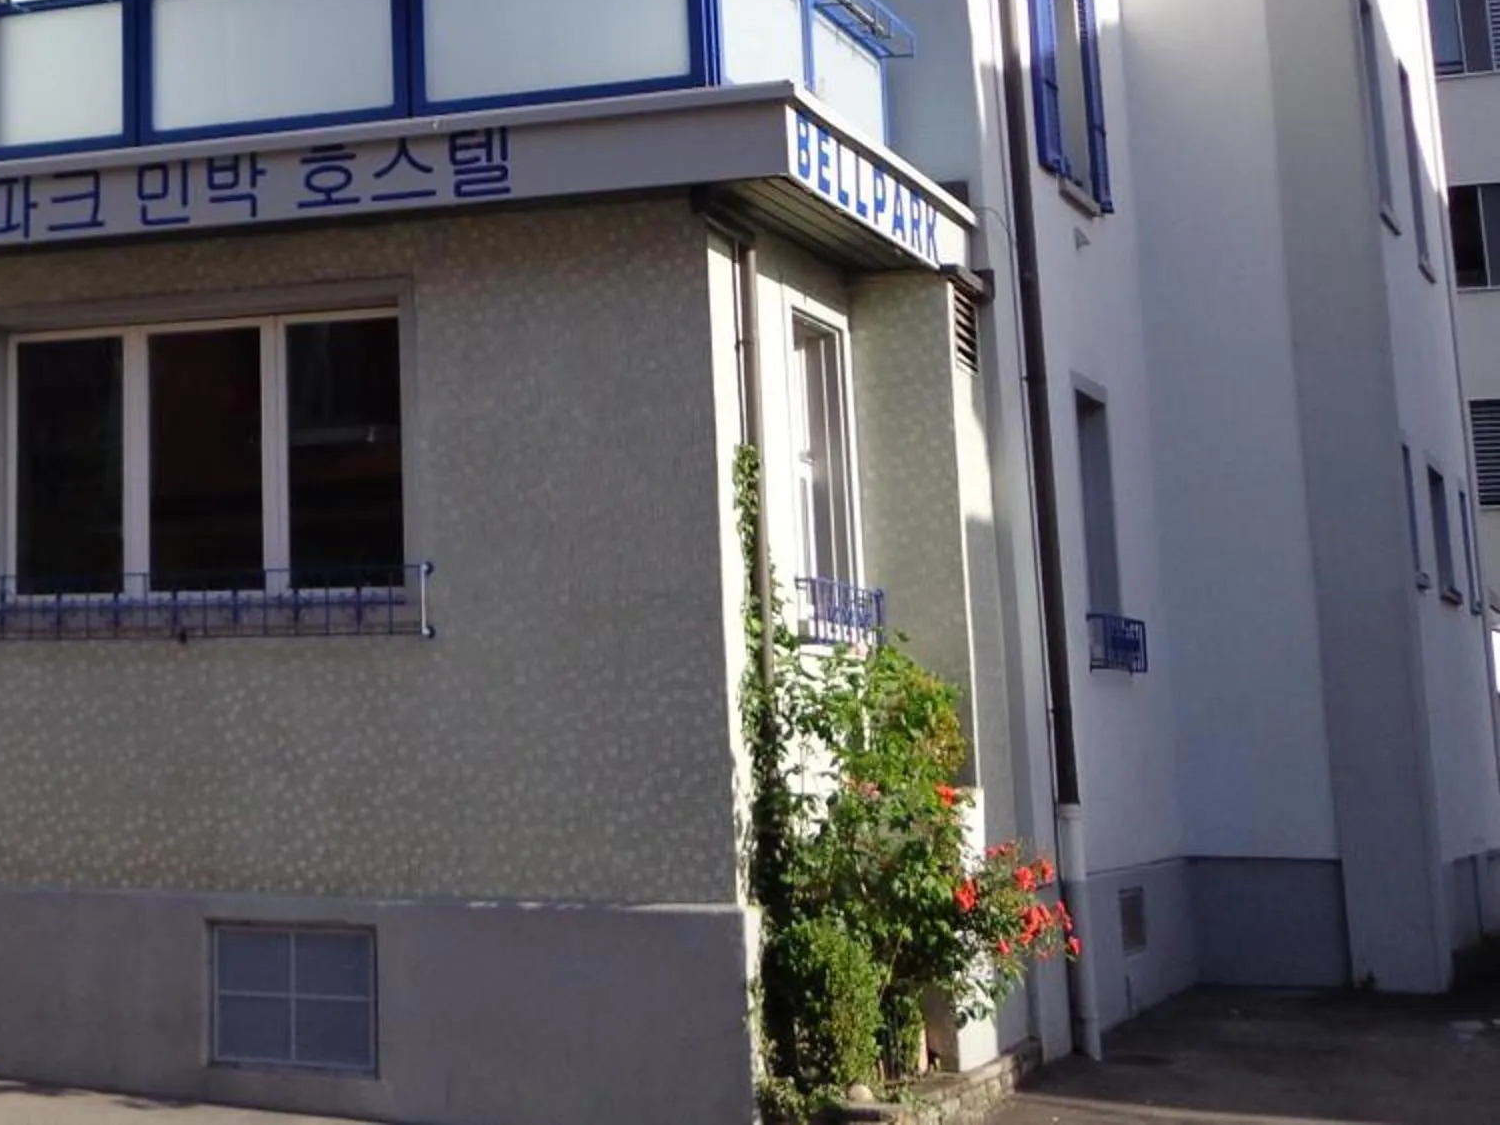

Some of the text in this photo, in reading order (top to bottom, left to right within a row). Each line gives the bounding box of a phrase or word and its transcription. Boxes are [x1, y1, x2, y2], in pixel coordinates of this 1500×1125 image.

[137, 154, 267, 226] 민박
[296, 126, 512, 209] 호스텔
[795, 110, 942, 265] BELLPARK
